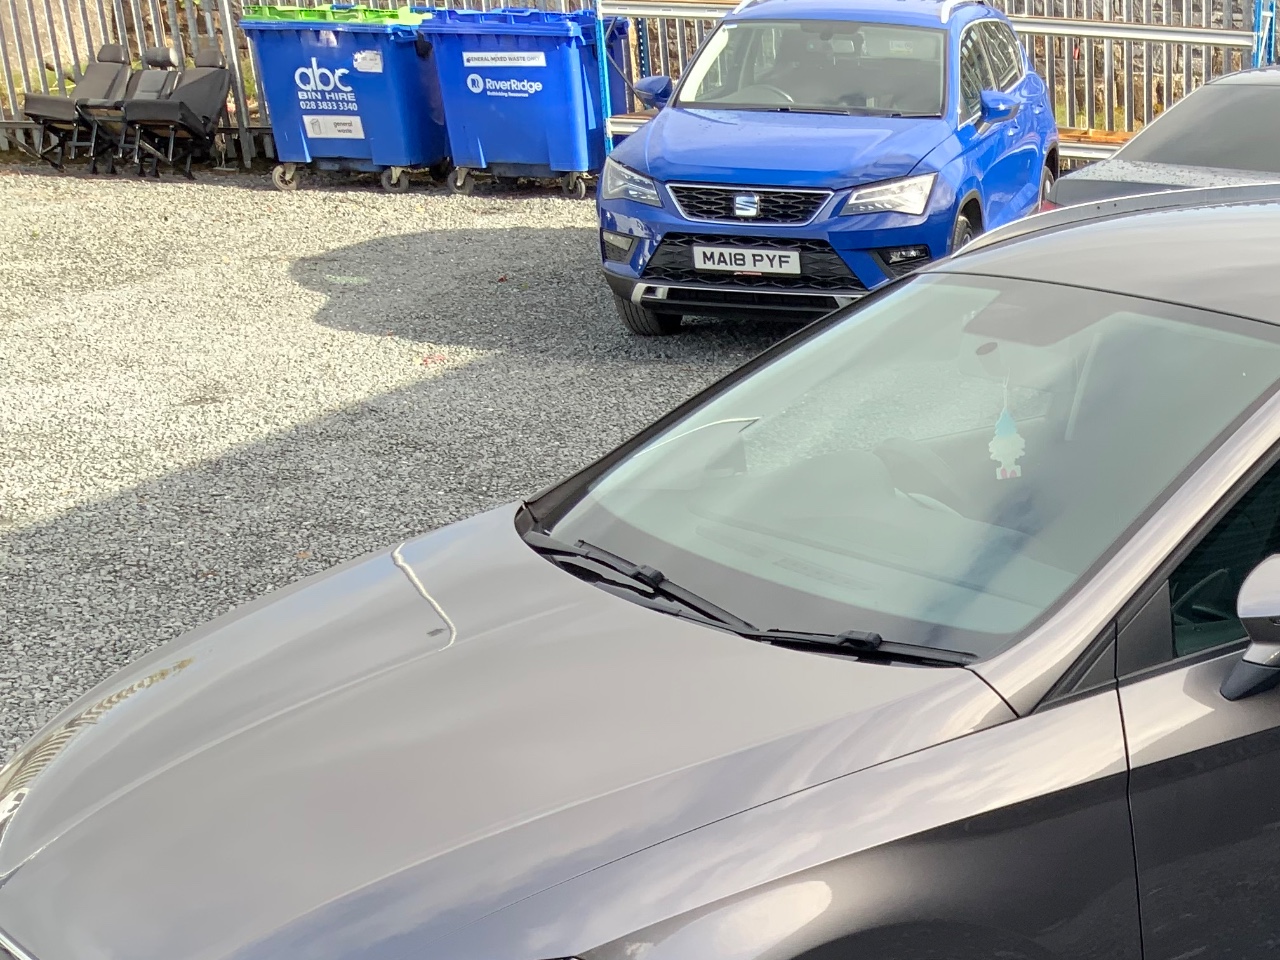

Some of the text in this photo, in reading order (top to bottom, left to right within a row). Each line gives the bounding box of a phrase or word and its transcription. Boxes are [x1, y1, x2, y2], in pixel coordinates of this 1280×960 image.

[294, 57, 353, 91] abc
[485, 78, 543, 94] RiverRidge
[297, 91, 356, 101] BIN HIRE
[299, 101, 358, 111] 028 3833 3340
[333, 120, 353, 128] general
[702, 250, 791, 268] MA18 PYF
